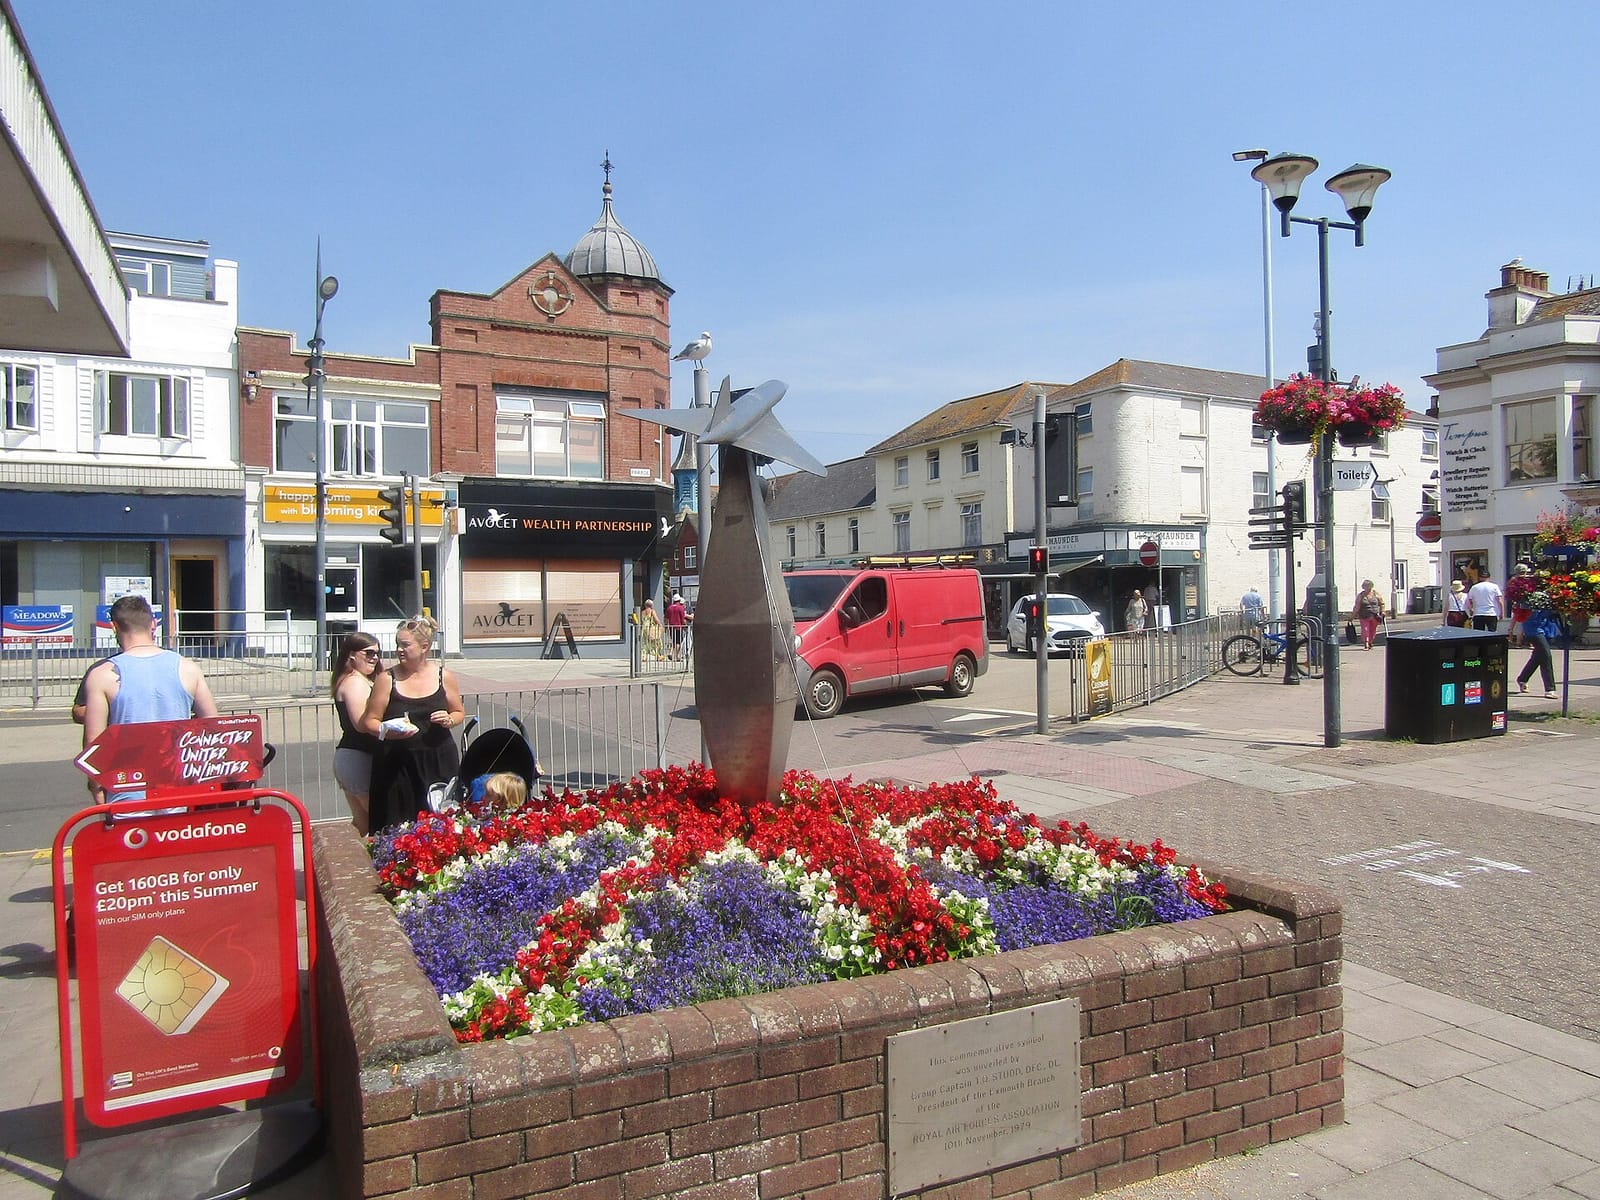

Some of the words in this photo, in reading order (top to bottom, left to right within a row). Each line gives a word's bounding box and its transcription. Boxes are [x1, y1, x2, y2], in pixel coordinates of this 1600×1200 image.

[1337, 470, 1370, 480] Toilets
[279, 490, 316, 502] happy
[469, 517, 518, 529] AVOCET
[522, 518, 570, 530] WEALTH
[575, 520, 652, 532] PARTNERSHIP
[1048, 536, 1079, 545] MAUNDER
[1160, 532, 1195, 540] MAUNDER
[13, 612, 66, 620] MEADOWS
[473, 614, 535, 627] AVOCET
[154, 822, 246, 842] vodafone
[96, 880, 124, 894] Get
[128, 873, 180, 890] 160GB
[182, 870, 206, 884] for
[208, 866, 242, 880] only
[160, 890, 190, 903] this
[193, 880, 258, 898] Summer
[98, 917, 116, 925] With
[148, 910, 164, 919] only
[166, 908, 186, 918] plans
[950, 1042, 1014, 1062] commemorative
[1017, 1034, 1044, 1048] symbol
[974, 1057, 1008, 1072] unveiled
[911, 1090, 936, 1100] Group
[940, 1080, 972, 1096] Captain
[917, 1094, 958, 1113] President
[973, 1091, 986, 1100] the
[989, 1082, 1024, 1097] Exmouth
[1027, 1074, 1056, 1087] Branch
[987, 1102, 1000, 1111] the
[912, 1130, 942, 1144] ROYAL
[946, 1124, 960, 1136] AIR
[962, 1116, 1000, 1131] FORCES
[1002, 1100, 1060, 1121] ASSOCIATION
